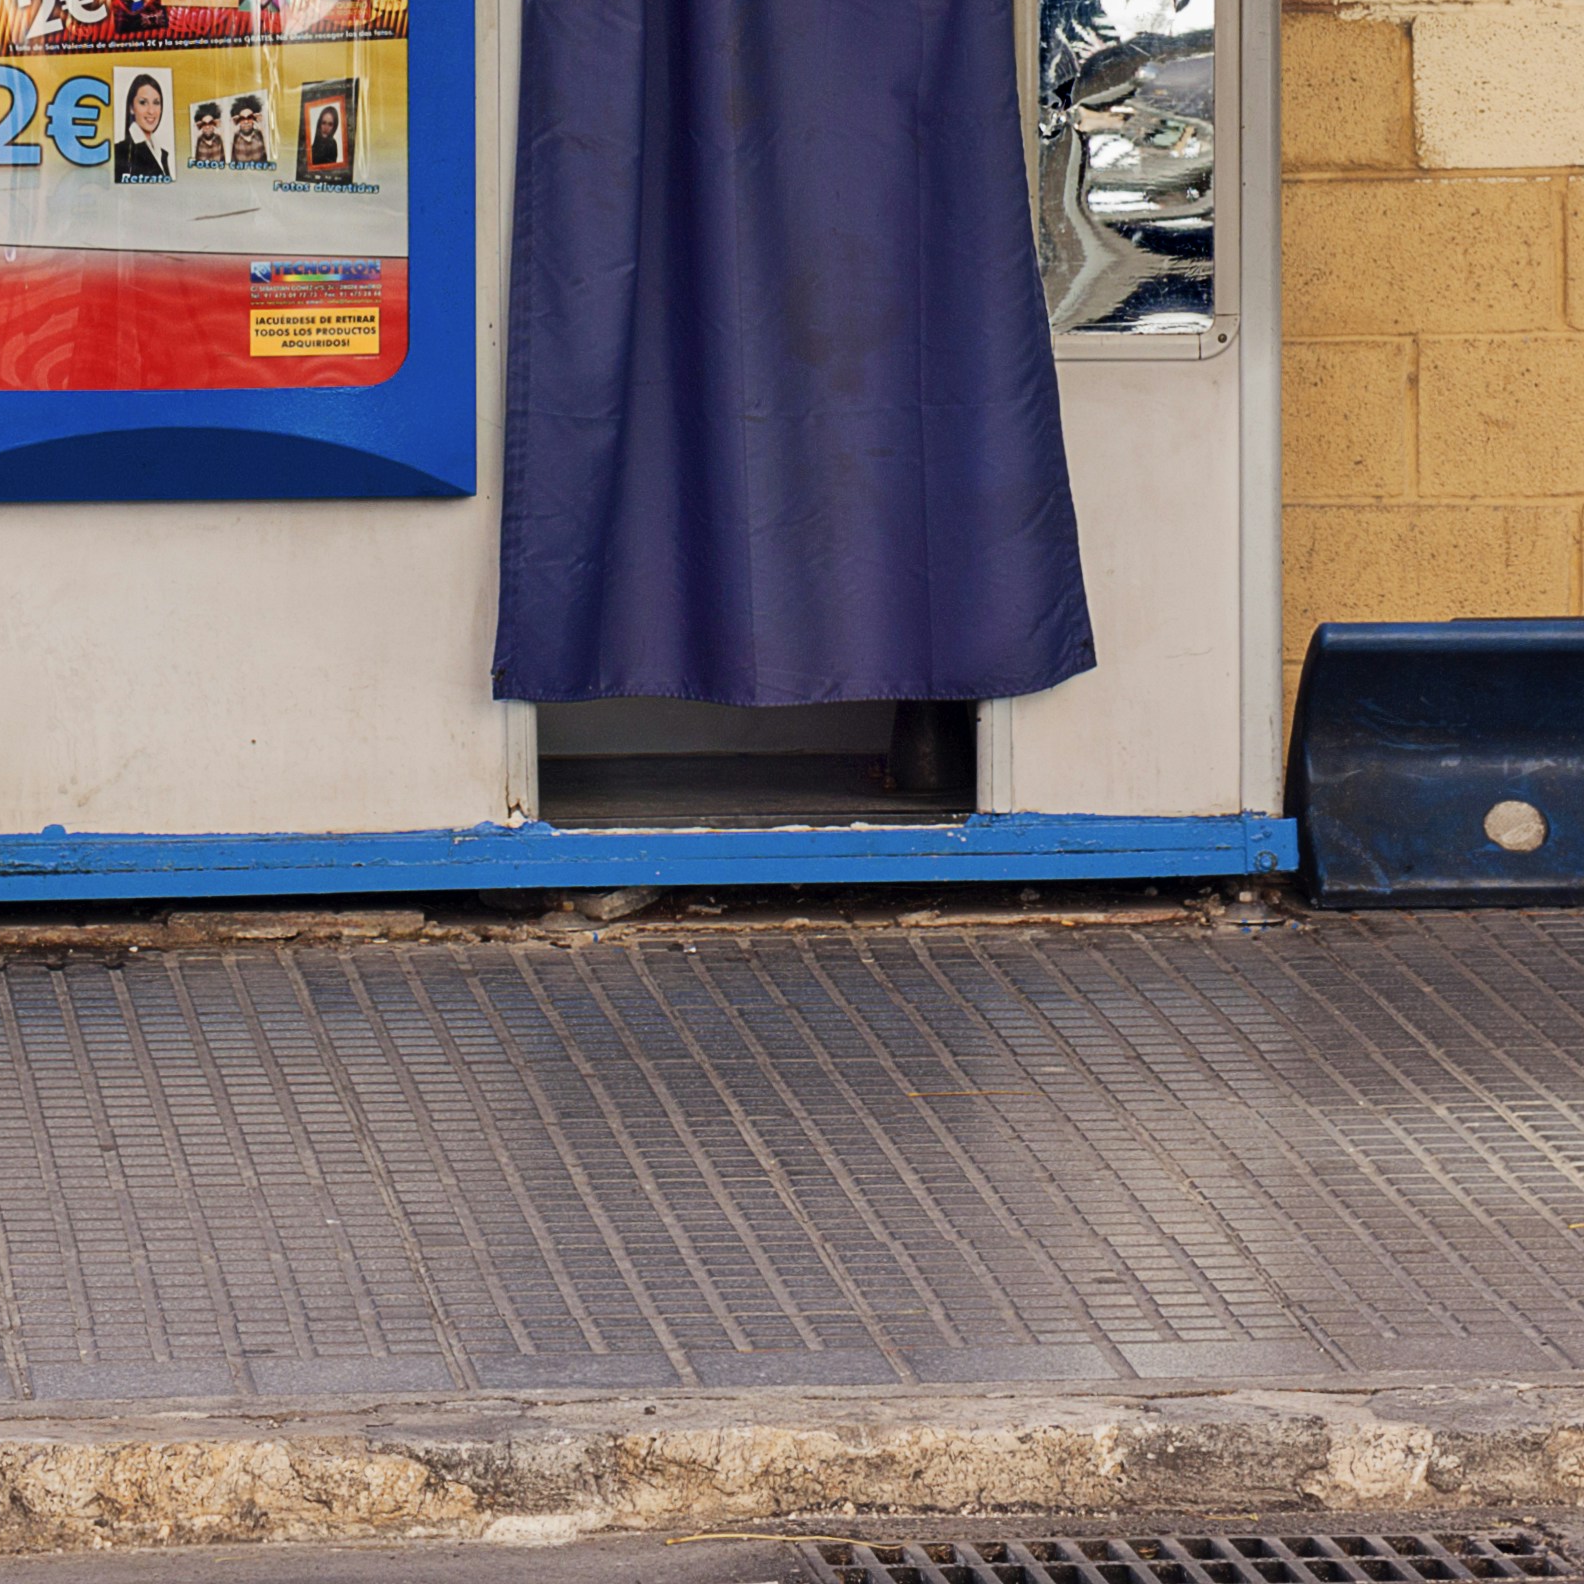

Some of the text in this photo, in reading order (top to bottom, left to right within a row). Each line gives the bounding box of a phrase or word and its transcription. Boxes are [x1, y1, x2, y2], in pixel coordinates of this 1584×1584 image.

[187, 158, 277, 171] Fotos cartera
[121, 173, 172, 184] Retrato
[273, 181, 380, 194] Fotos divertidas
[273, 259, 381, 275] TECNOTRON
[336, 315, 375, 323] RETIRAR
[255, 326, 376, 336] TODOS LOS PRODUCTOS
[282, 339, 350, 348] ADQUIRIDOS!
